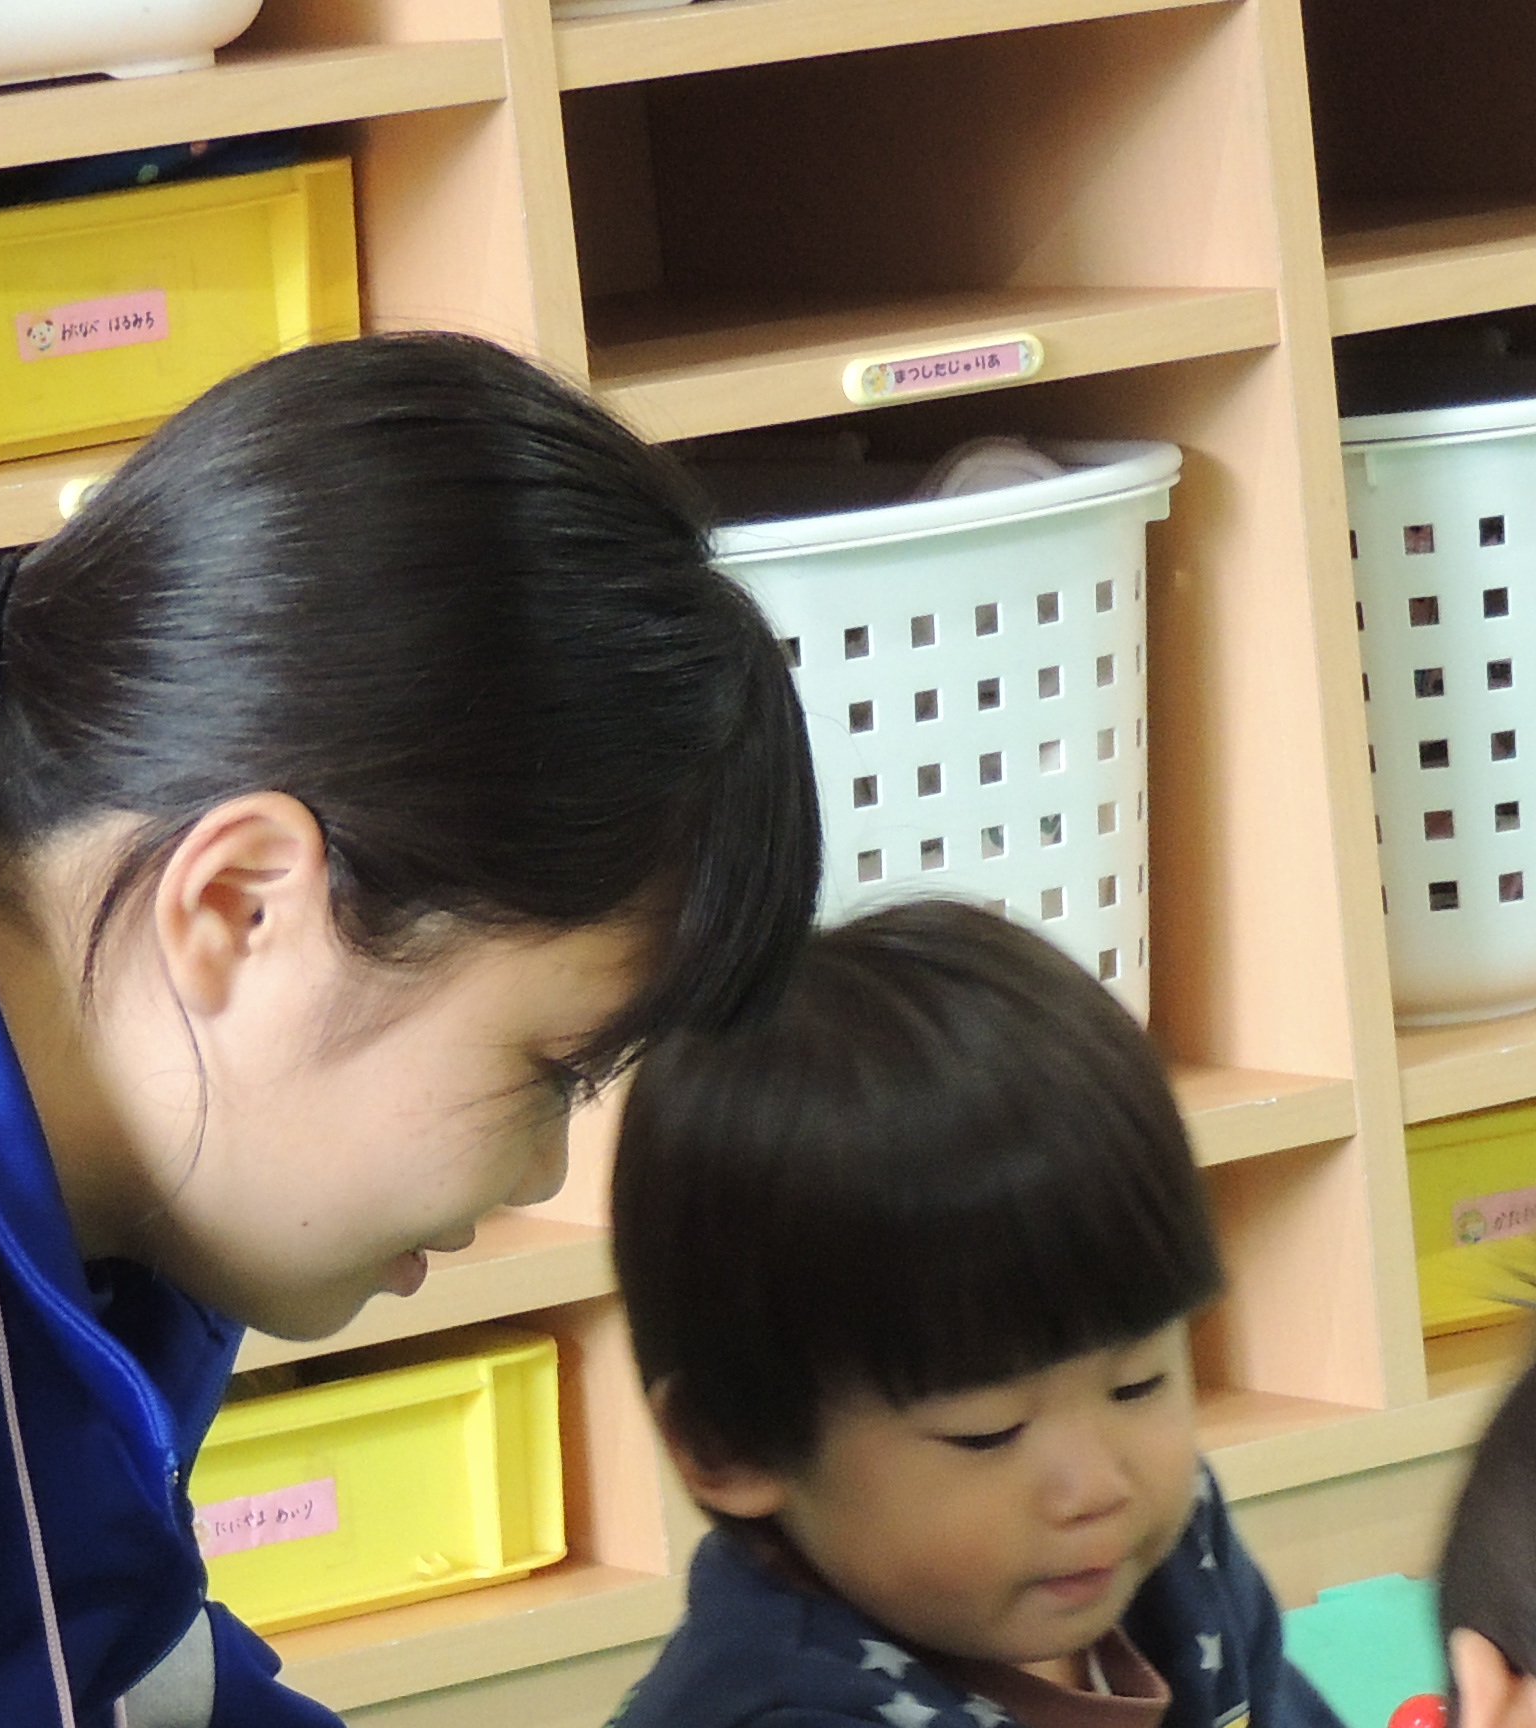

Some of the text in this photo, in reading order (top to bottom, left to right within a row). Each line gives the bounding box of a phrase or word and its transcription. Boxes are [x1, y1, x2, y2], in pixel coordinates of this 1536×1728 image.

[894, 353, 1001, 384] まつしたじゅりあ
